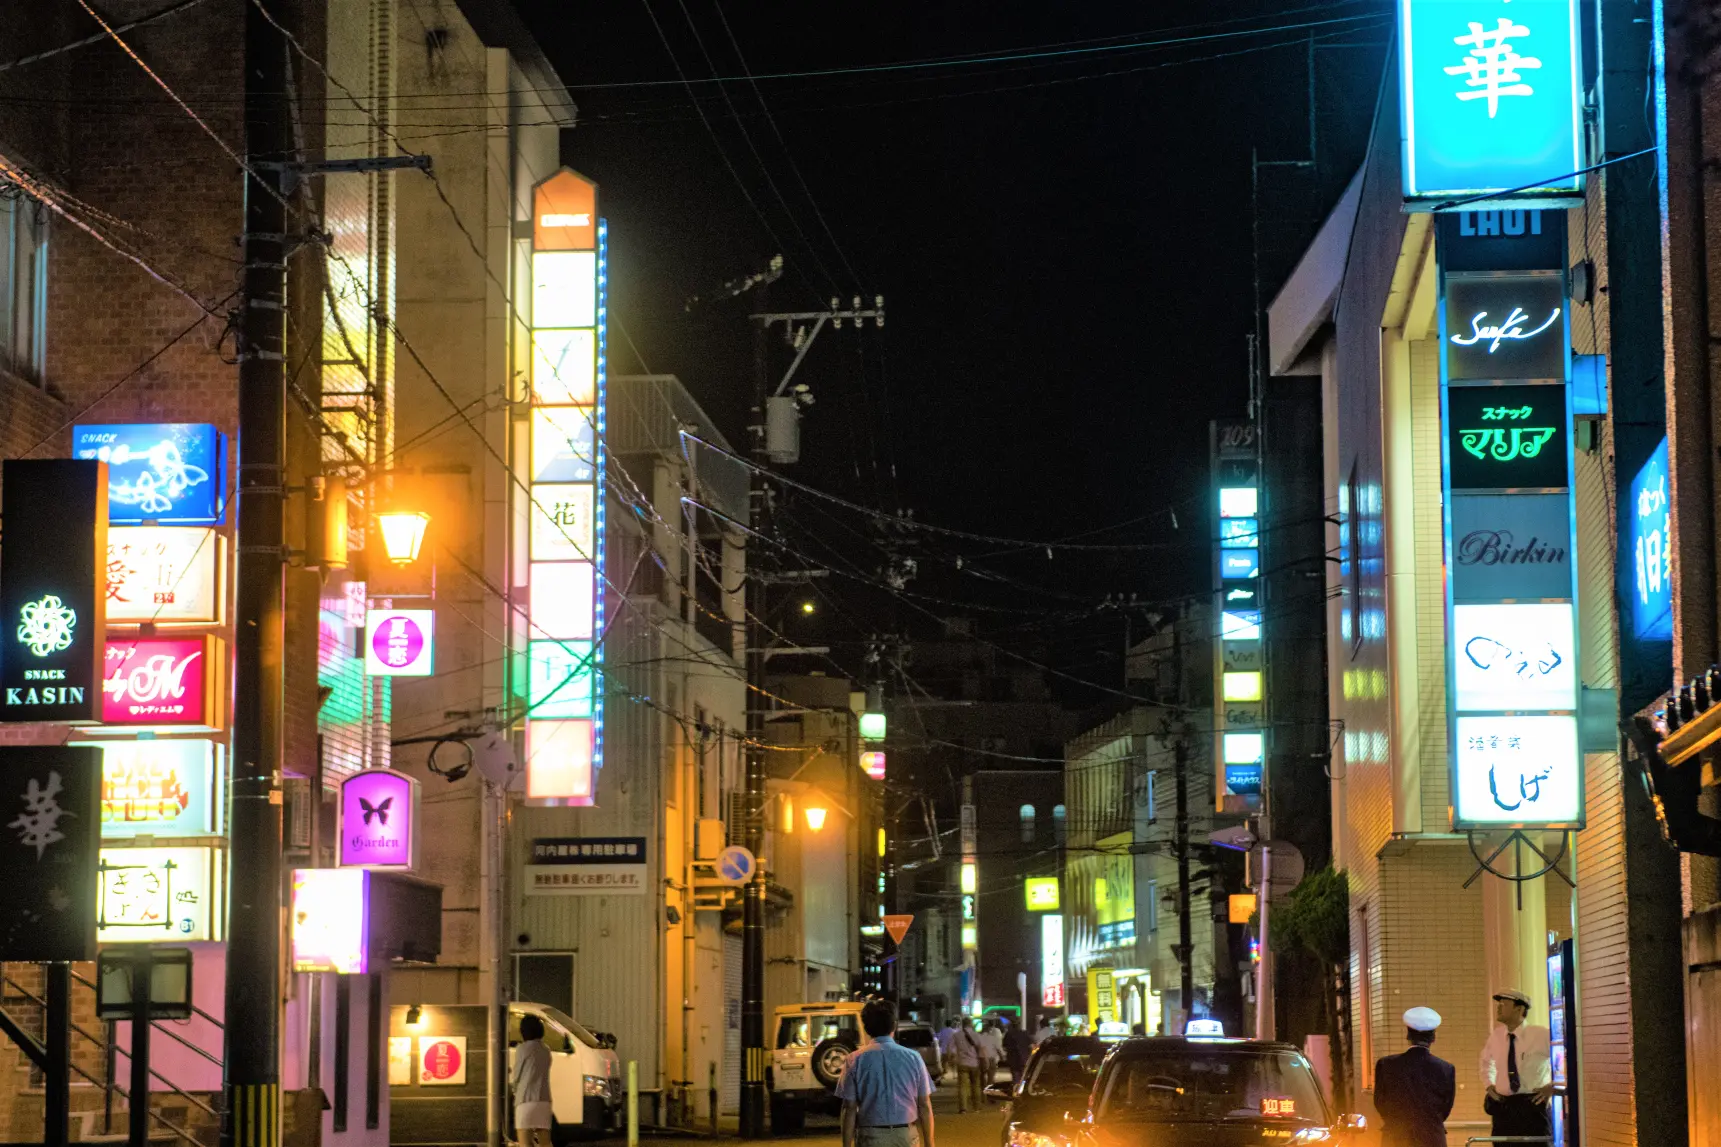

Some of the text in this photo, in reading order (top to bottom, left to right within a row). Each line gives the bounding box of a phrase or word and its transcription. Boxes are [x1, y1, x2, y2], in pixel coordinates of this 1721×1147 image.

[1443, 18, 1543, 119] 華
[1482, 406, 1533, 420] スナック
[80, 433, 117, 444] SNACK
[1459, 427, 1556, 461] マリア
[552, 502, 576, 526] 花
[1457, 529, 1566, 566] Birkin
[24, 669, 65, 680] SNACK
[6, 686, 85, 706] KASIN
[1489, 763, 1553, 812] しげ
[6, 770, 78, 863] 華
[352, 835, 399, 852] Garden
[1263, 1099, 1295, 1114] 迎車
